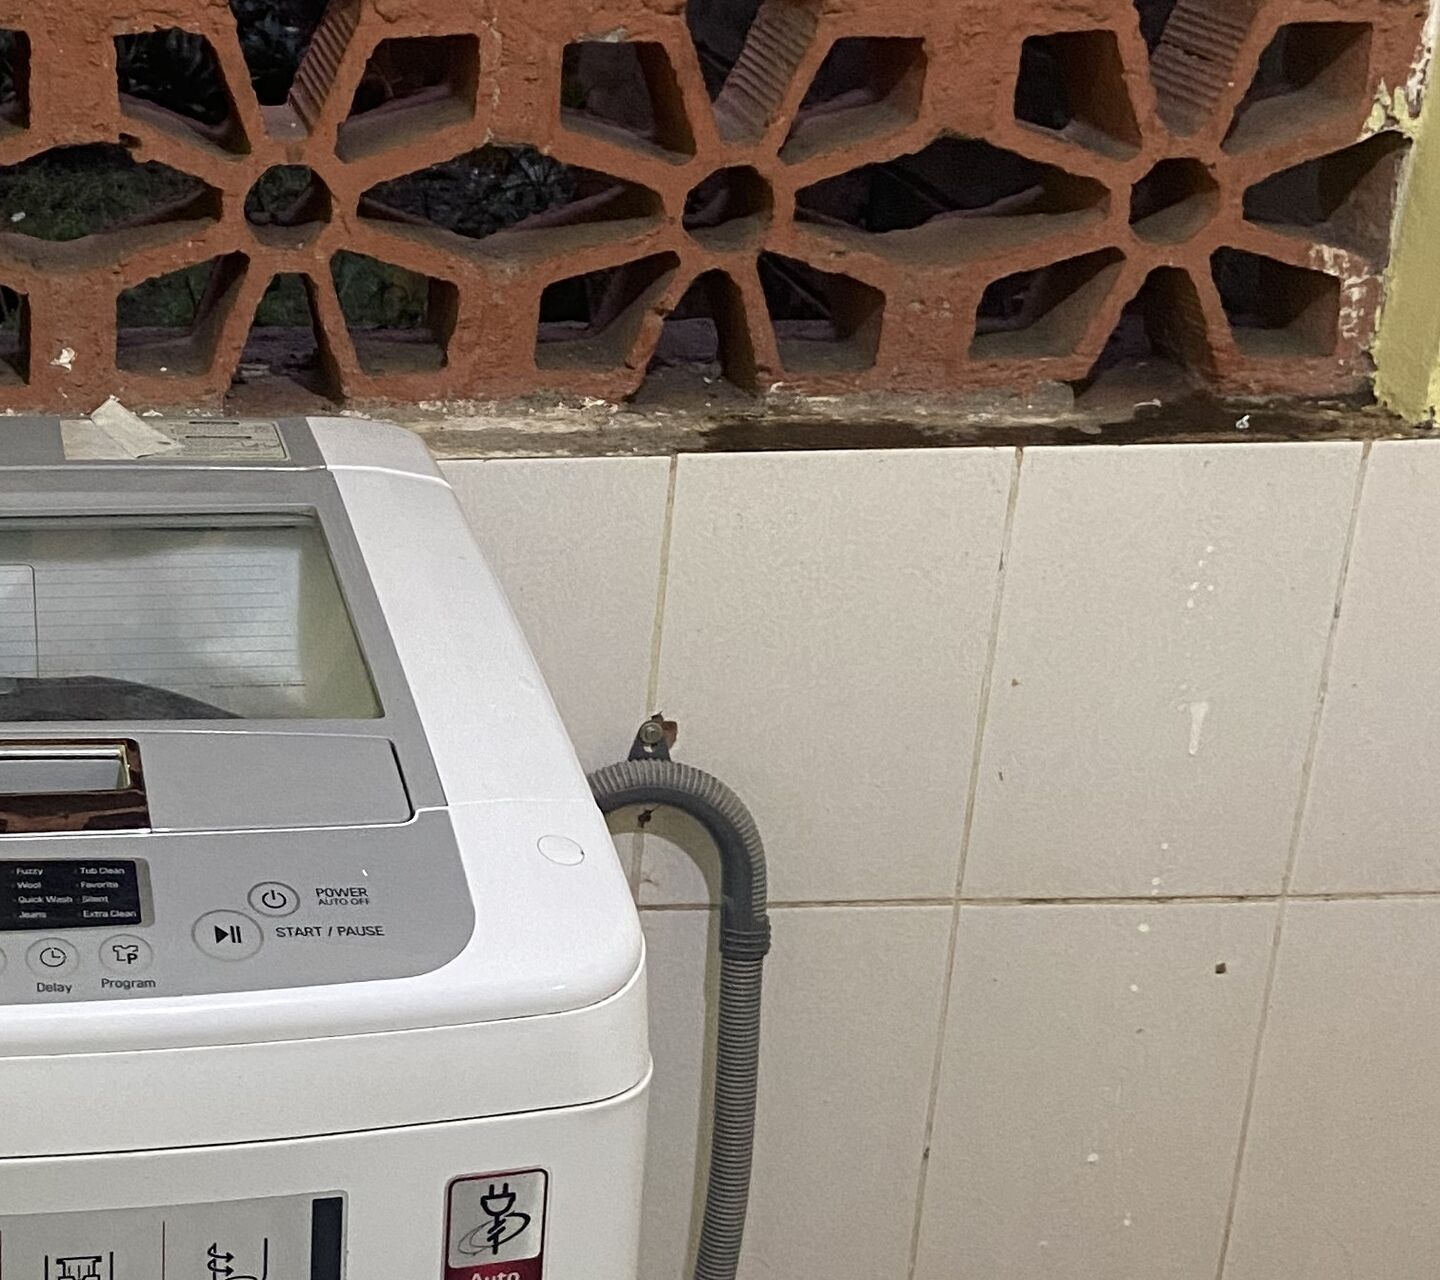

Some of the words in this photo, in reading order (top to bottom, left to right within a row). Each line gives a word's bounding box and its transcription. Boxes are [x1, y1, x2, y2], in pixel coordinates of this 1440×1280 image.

[16, 868, 44, 876] Fuzzy
[80, 867, 97, 875] Tub
[99, 867, 125, 875] Clean
[80, 881, 119, 889] Favorite
[315, 887, 369, 897] POWER
[318, 898, 348, 906] AUTO
[83, 910, 108, 918] Extra
[110, 910, 137, 918] Clean
[275, 926, 322, 937] START
[337, 925, 385, 937] PAUSE
[36, 982, 73, 994] Delay
[101, 978, 156, 990] Program
